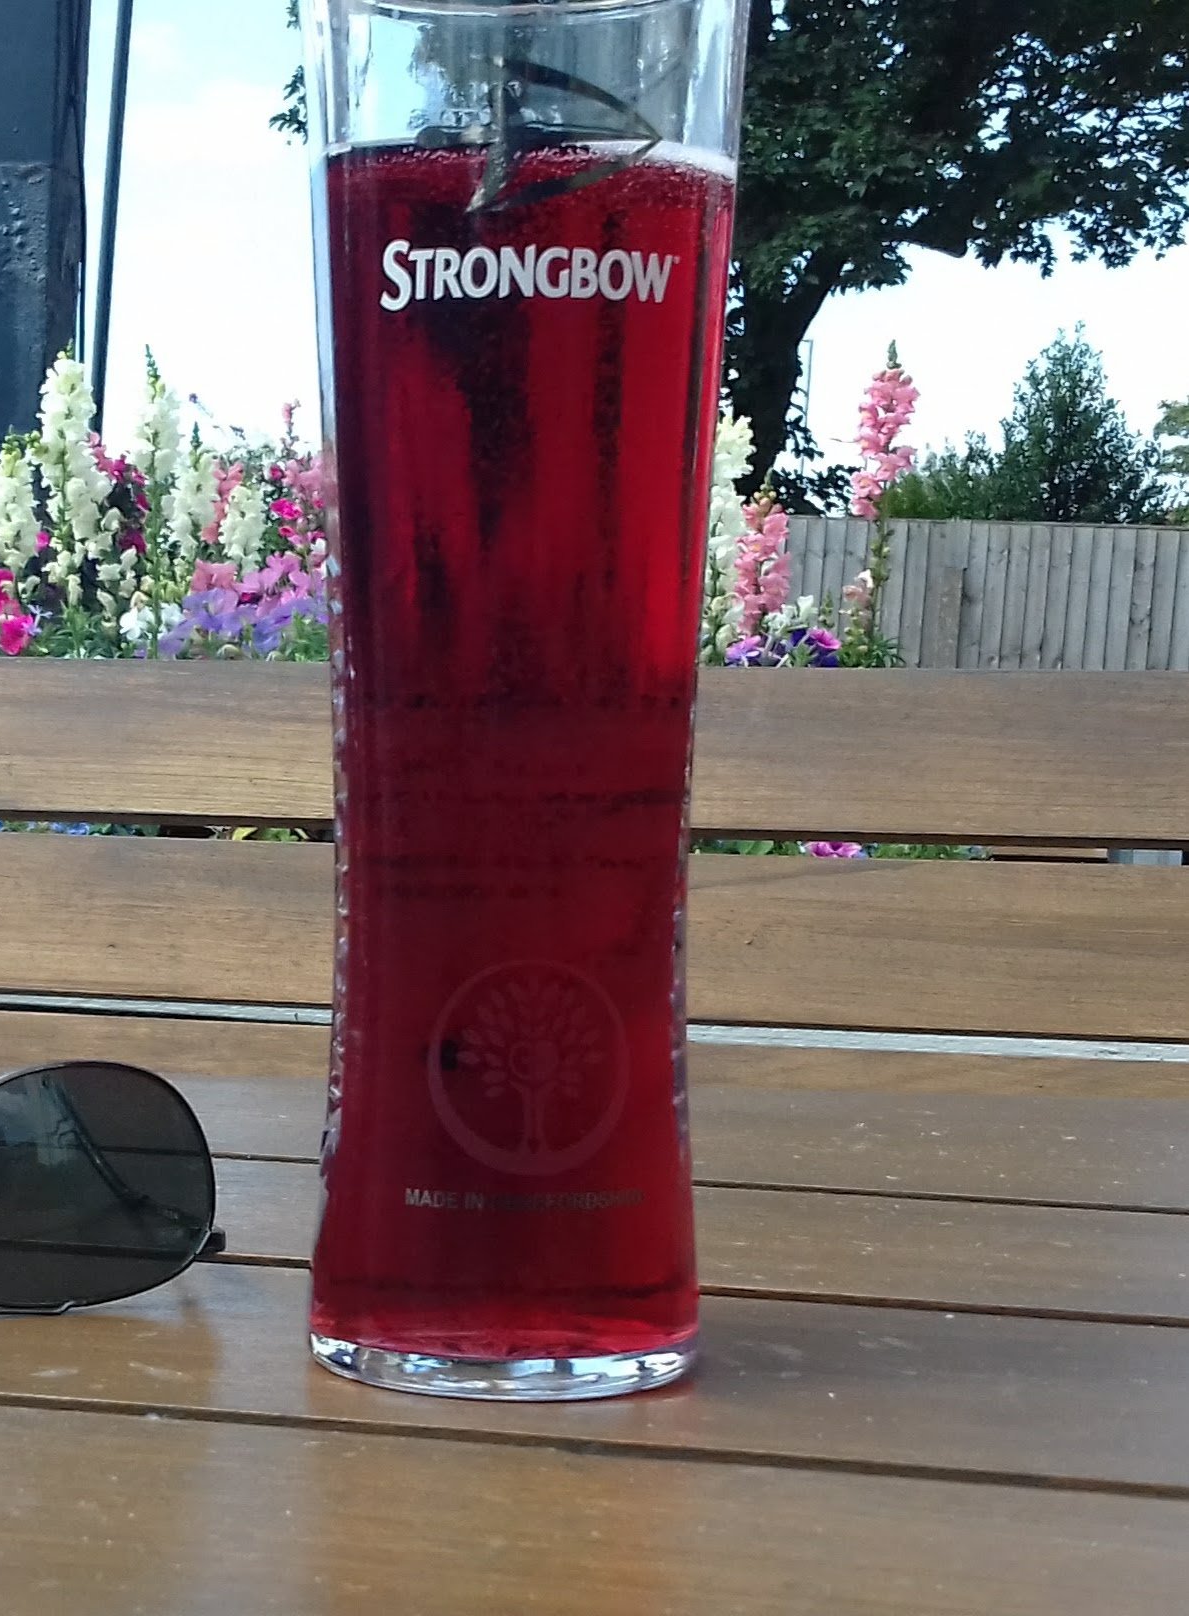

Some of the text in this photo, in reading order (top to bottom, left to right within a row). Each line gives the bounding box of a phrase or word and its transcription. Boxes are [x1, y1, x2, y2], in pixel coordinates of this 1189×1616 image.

[380, 239, 674, 312] STRONGBOW
[405, 1187, 458, 1209] MADE
[465, 1191, 485, 1210] IN
